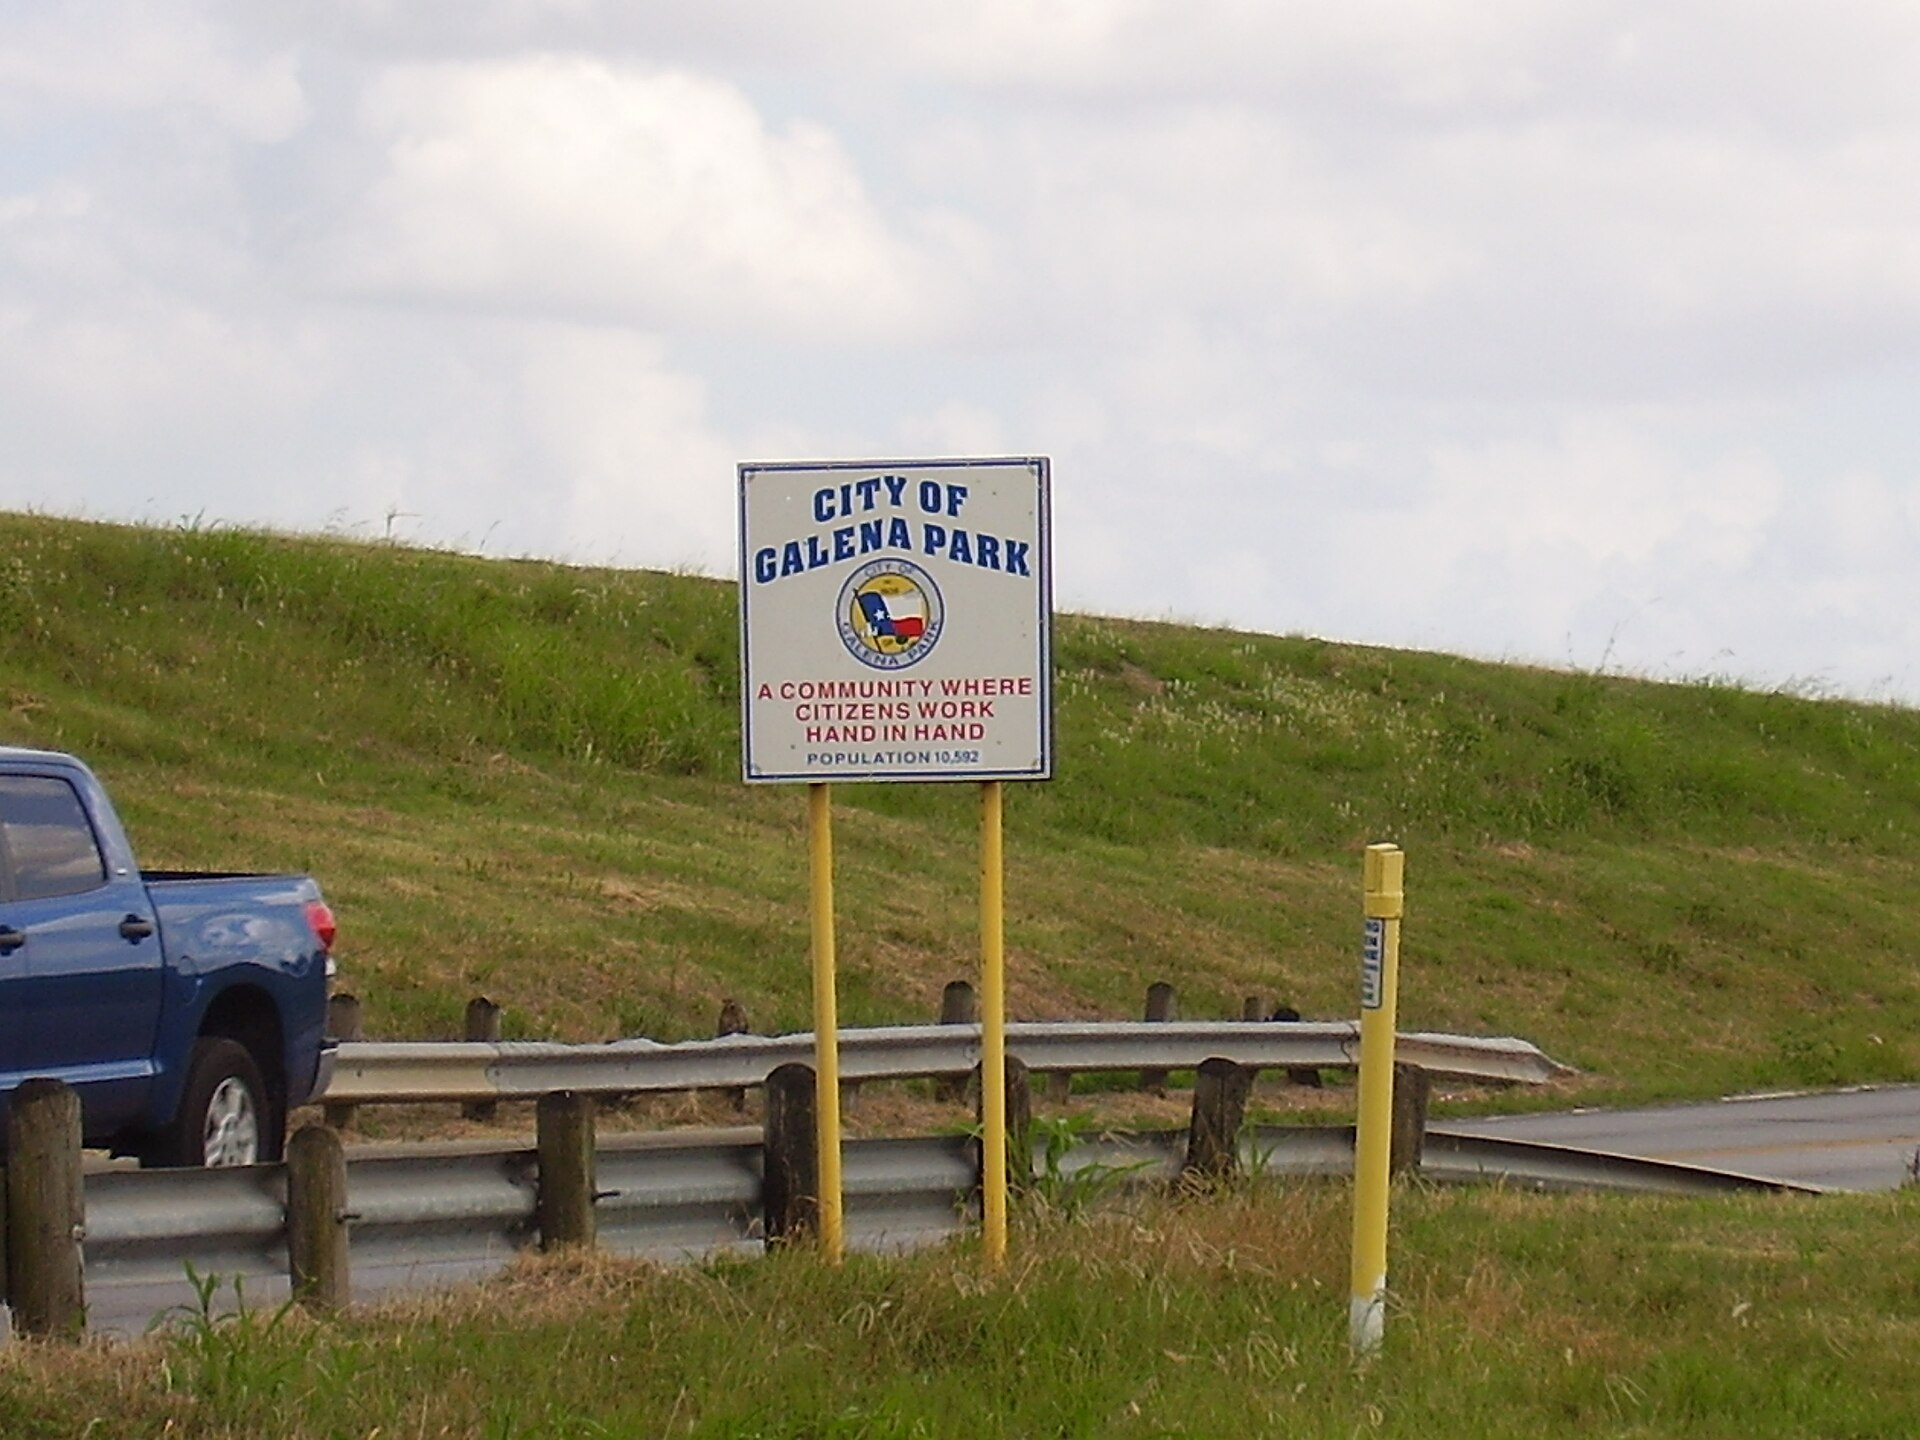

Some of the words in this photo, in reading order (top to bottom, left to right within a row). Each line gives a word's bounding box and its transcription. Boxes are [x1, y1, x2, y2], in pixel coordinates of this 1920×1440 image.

[814, 475, 907, 522] CITY
[919, 480, 969, 517] OF
[755, 517, 912, 583] GALENA
[923, 523, 1031, 577] PARK
[757, 683, 773, 699] A
[780, 680, 934, 700] COMMUNITY
[939, 678, 1033, 697] WHERE
[795, 703, 911, 721] CITIZENS
[917, 701, 995, 719] WORK
[806, 725, 877, 743] HAND
[883, 724, 907, 742] IN
[914, 723, 986, 741] HAND
[807, 751, 931, 765] POPULATION
[934, 750, 979, 764] 10,592
